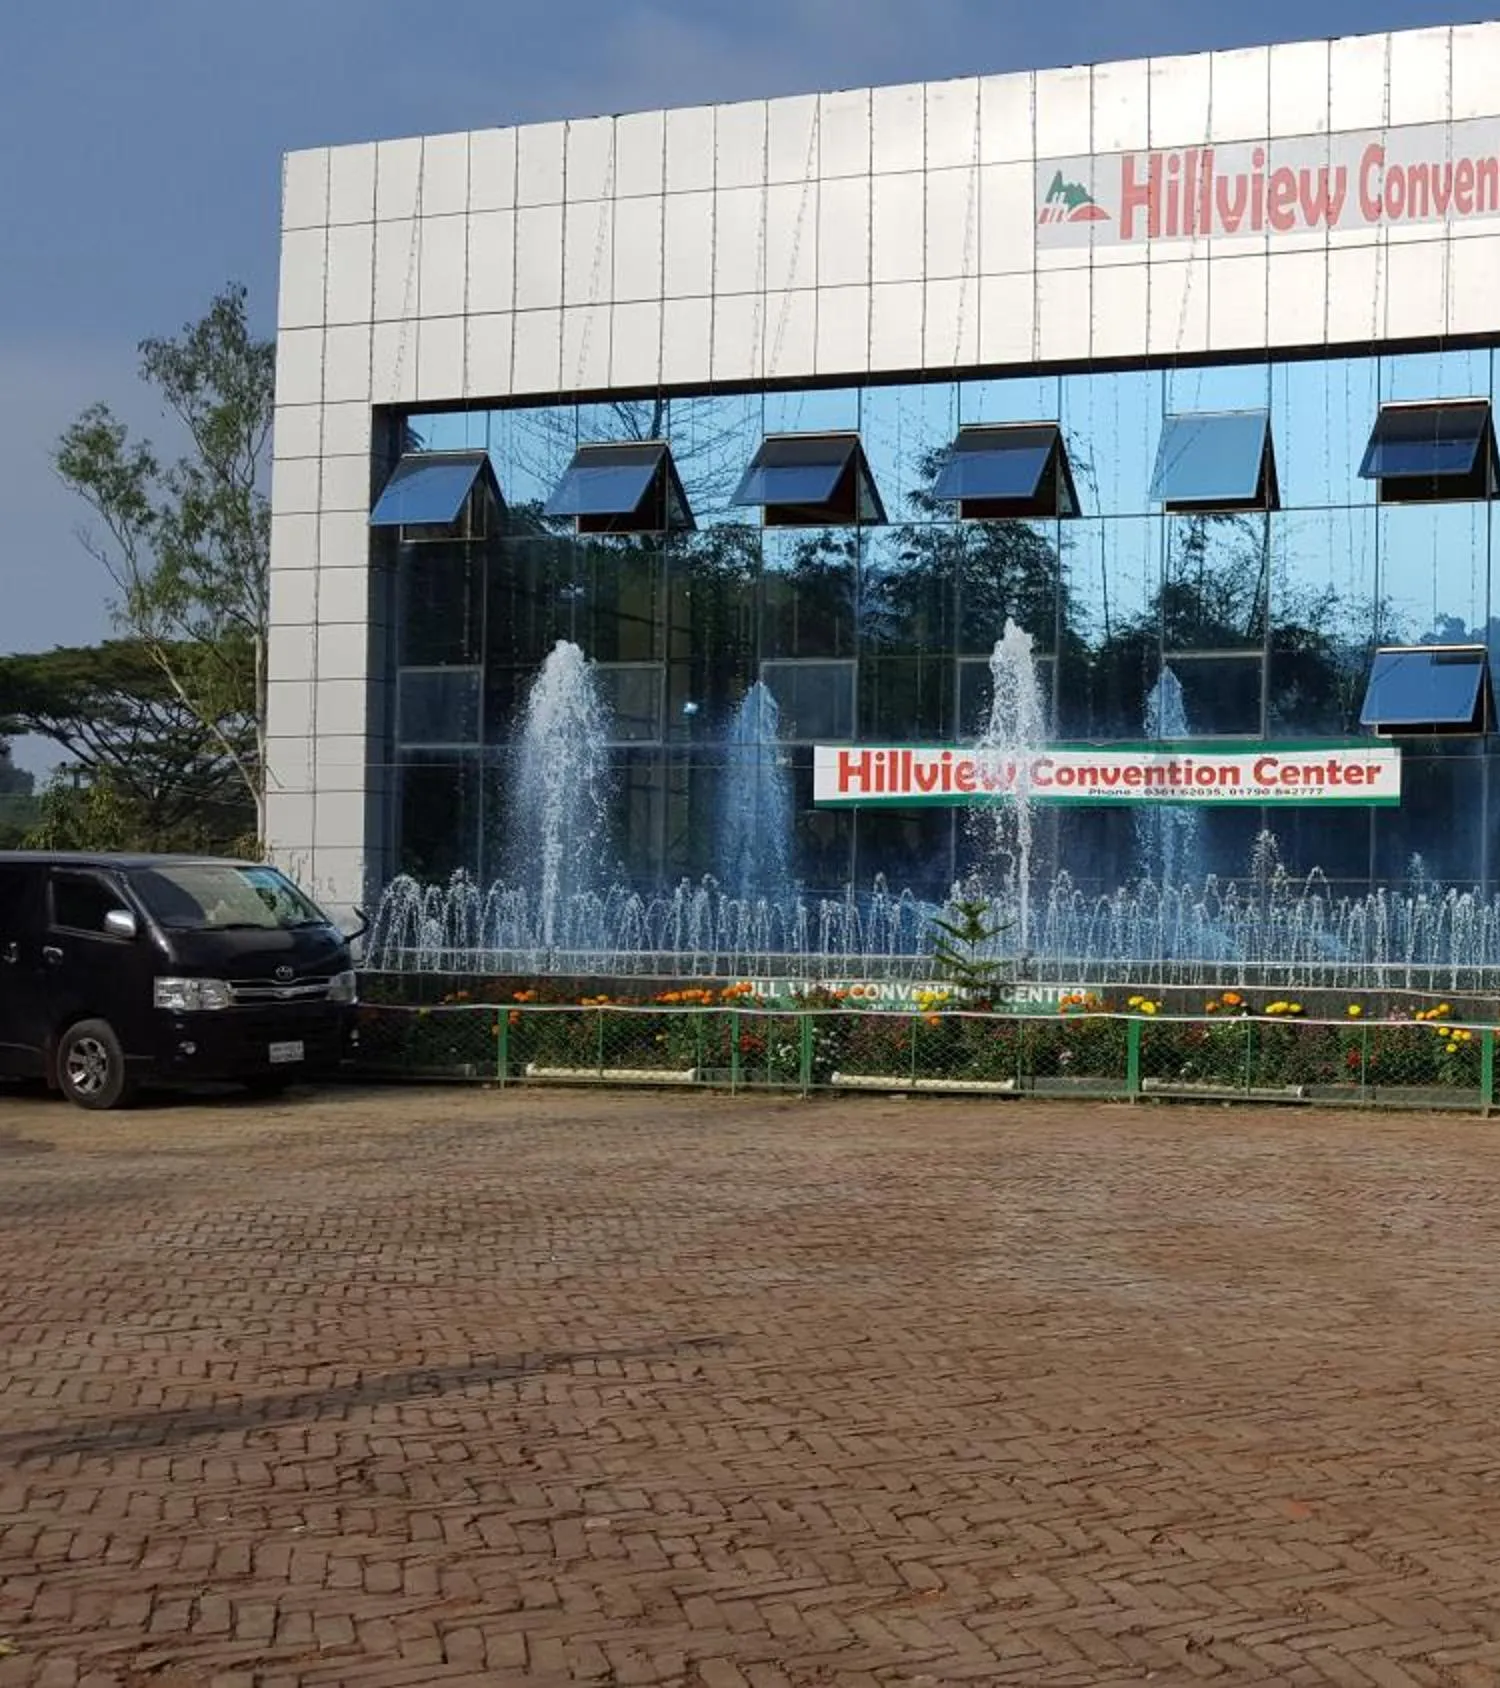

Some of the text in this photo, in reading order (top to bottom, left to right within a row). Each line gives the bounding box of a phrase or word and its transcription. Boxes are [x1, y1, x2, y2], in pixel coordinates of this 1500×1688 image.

[1119, 146, 1347, 241] Hillview
[838, 750, 1382, 793] Hillview Convention Center
[1088, 787, 1131, 796] Phone
